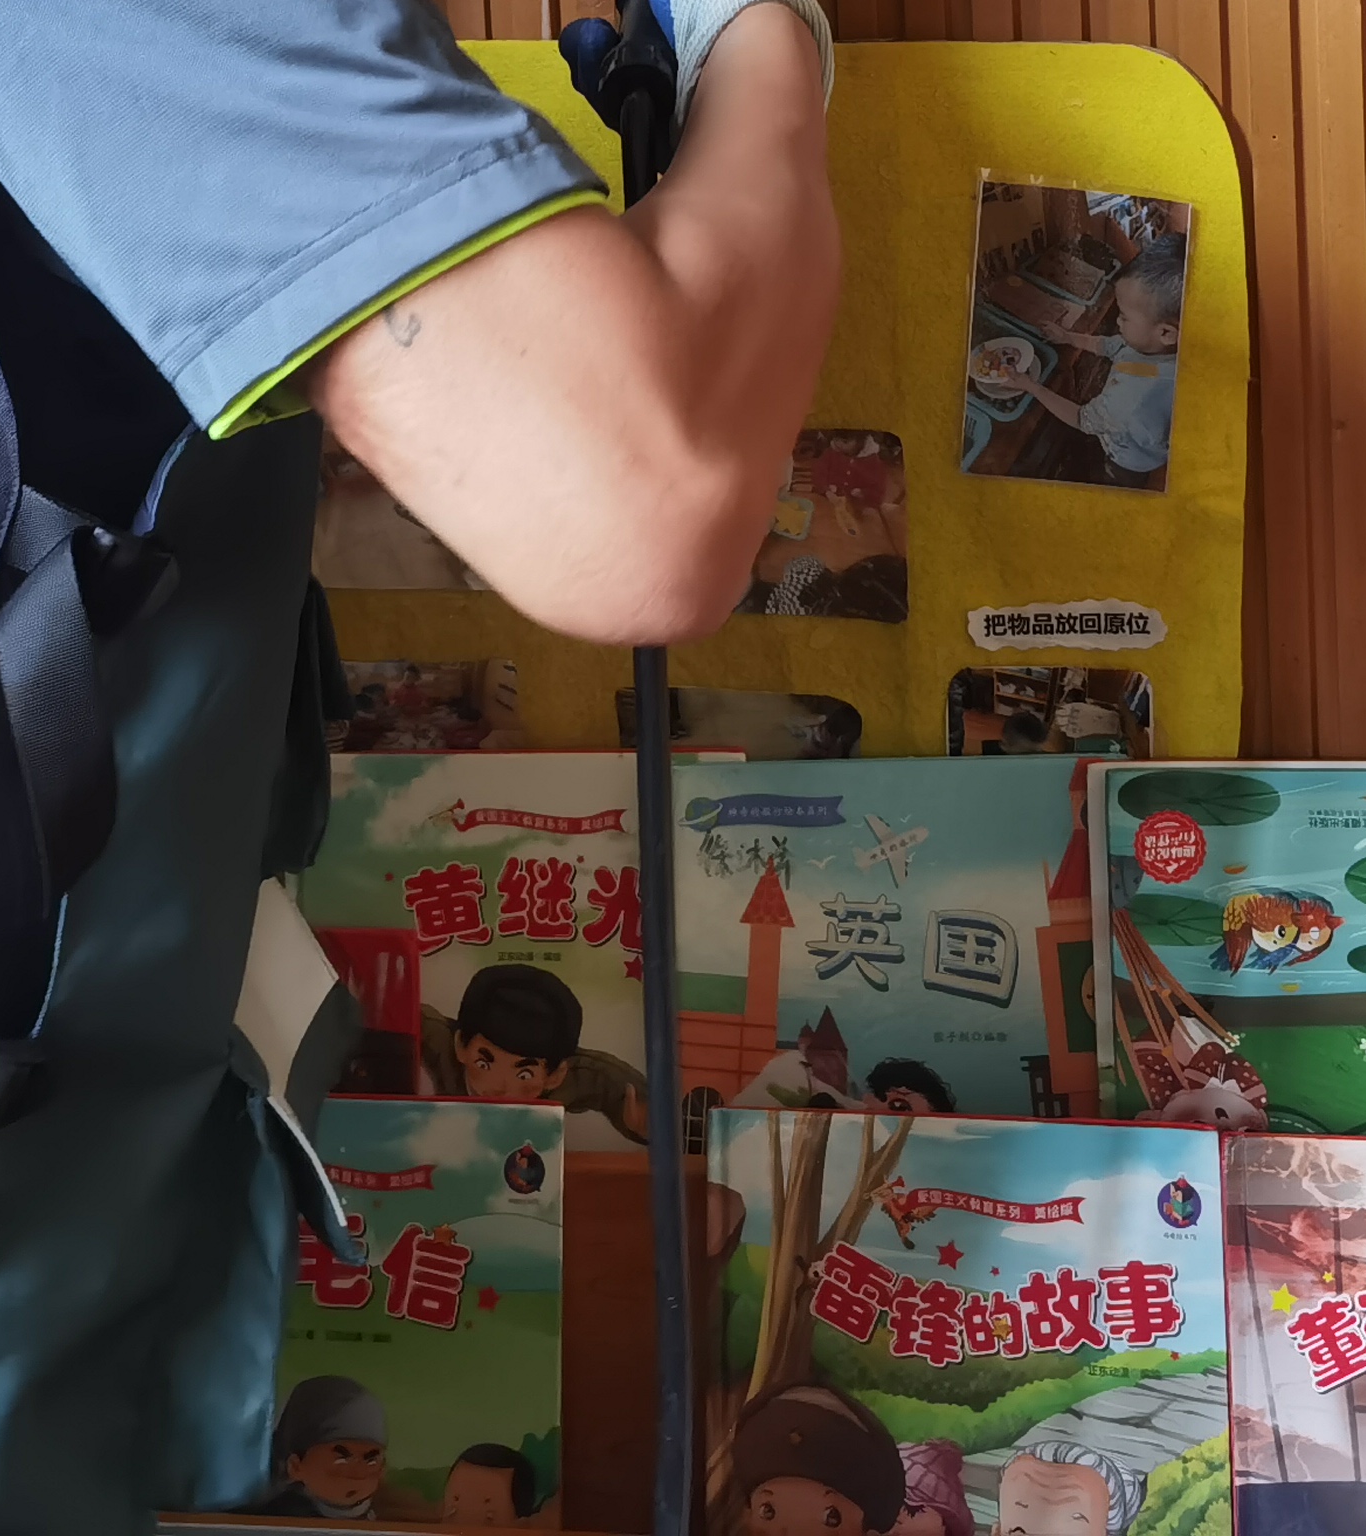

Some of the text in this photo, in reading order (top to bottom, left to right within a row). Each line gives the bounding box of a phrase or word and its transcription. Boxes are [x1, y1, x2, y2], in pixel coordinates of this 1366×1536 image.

[983, 612, 1151, 637] 把物品放回原位
[808, 892, 1019, 1007] 英国
[810, 1241, 1185, 1368] 雷锋的故事
